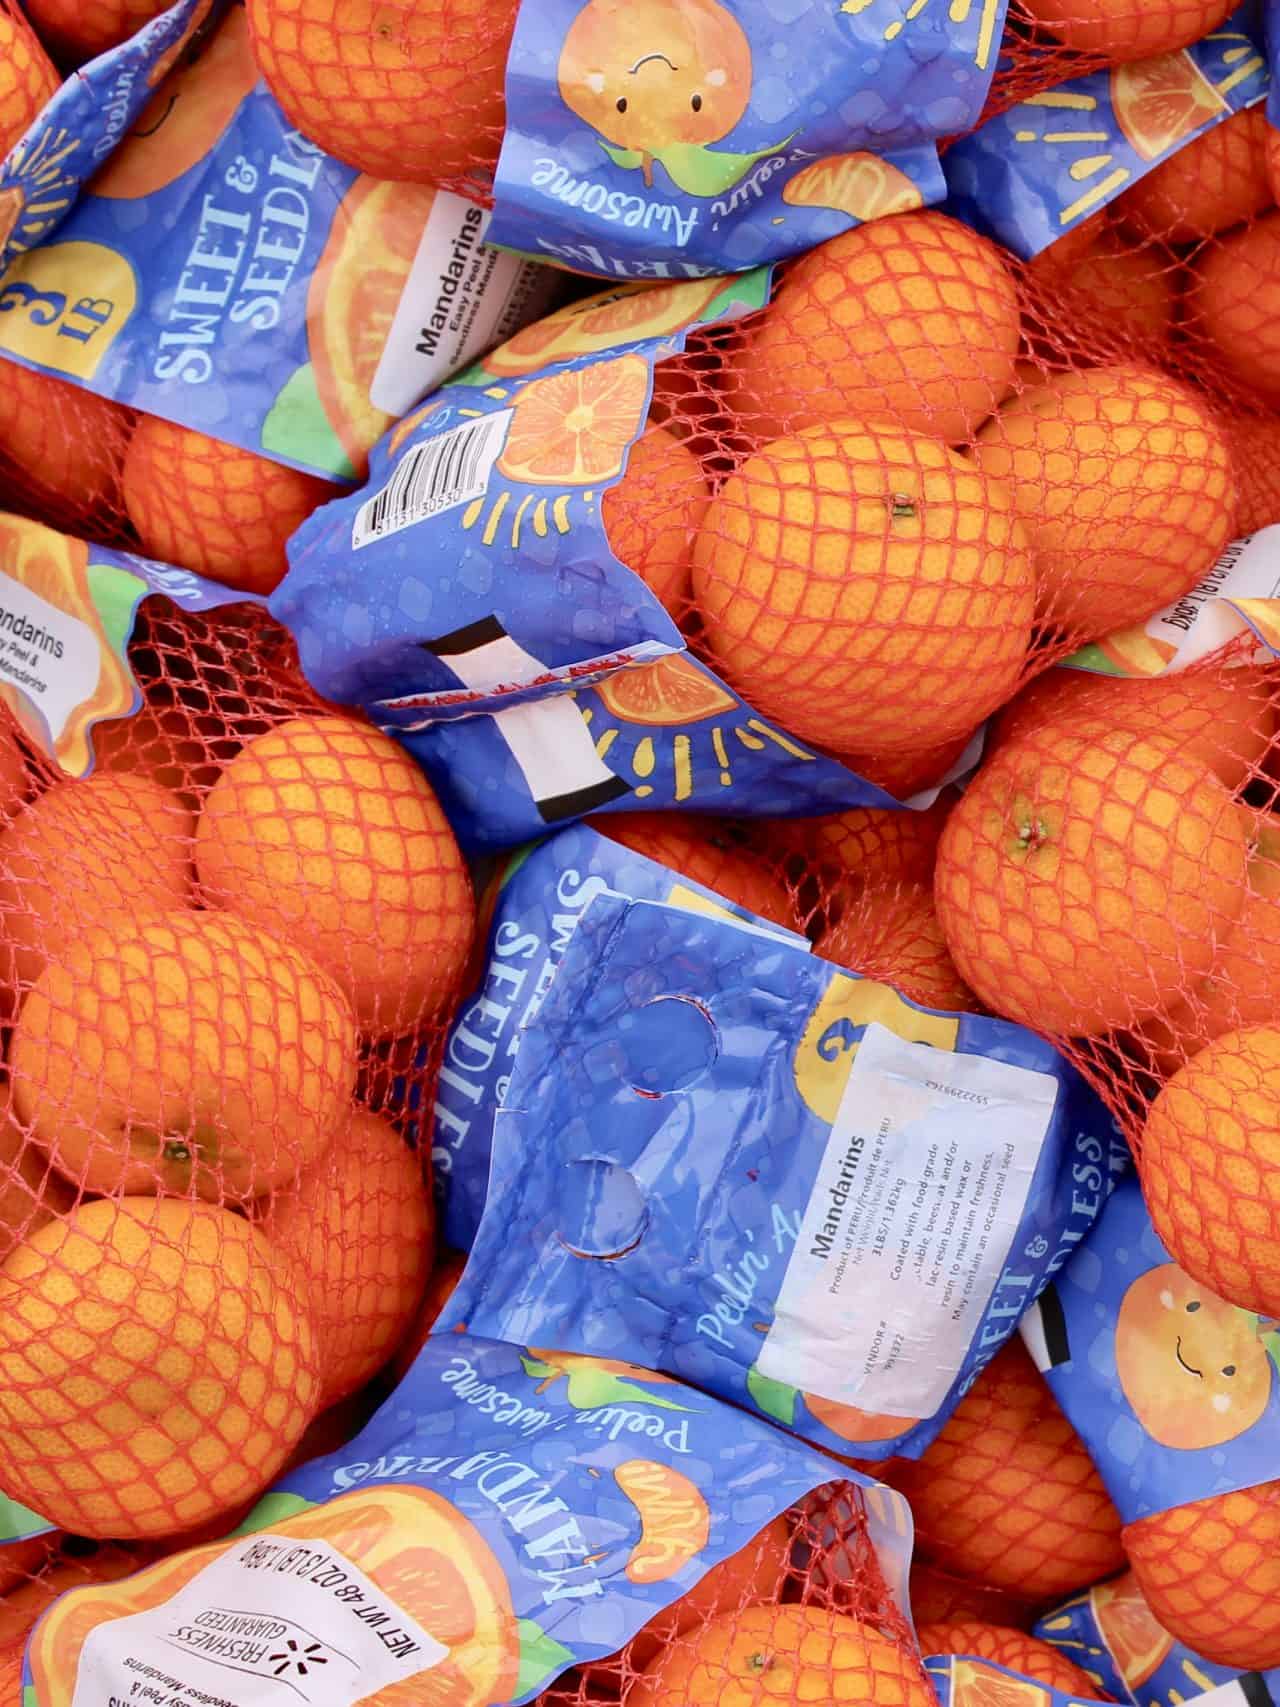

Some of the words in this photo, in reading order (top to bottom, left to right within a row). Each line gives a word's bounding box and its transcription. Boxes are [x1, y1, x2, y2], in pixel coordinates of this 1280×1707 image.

[532, 158, 699, 247] Awesome
[154, 193, 253, 383] SWEET
[225, 155, 258, 194] &
[416, 207, 482, 357] Mandarins
[0, 282, 67, 326] 3
[449, 296, 471, 332] Easy
[464, 260, 483, 292] Peel
[56, 297, 115, 344] LB
[0, 608, 64, 659] andarins
[431, 921, 541, 1173] SEEDLES
[873, 1146, 884, 1162] de
[878, 1117, 892, 1147] PERU
[943, 1140, 959, 1179] and/or
[811, 1135, 865, 1260] Mandarins
[944, 1199, 961, 1236] based
[956, 1174, 969, 1200] wax
[963, 1159, 973, 1174] or
[846, 1233, 856, 1250] of
[890, 1240, 910, 1281] Coated
[907, 1212, 919, 1239] with
[951, 1295, 969, 1322] May
[963, 1255, 983, 1296] contain
[977, 1234, 989, 1251] an
[983, 1171, 1006, 1233] occasional
[1000, 1141, 1015, 1171] seed
[1024, 1234, 1049, 1260] &
[831, 1249, 850, 1294] Product
[941, 1277, 957, 1309] resin
[951, 1262, 962, 1277] to
[957, 1207, 976, 1262] maintain
[696, 1229, 769, 1349] Peelin'
[863, 1330, 885, 1376] VENDOR
[440, 1358, 560, 1438] Awesome
[555, 1407, 694, 1453] Peelin'
[331, 1450, 605, 1604] MANDARINS
[310, 1563, 348, 1589] OZ
[333, 1584, 366, 1604] 48
[194, 1610, 287, 1638] GUARANTEED
[352, 1606, 392, 1630] WT
[168, 1625, 270, 1665] FRESHNESS
[376, 1627, 421, 1659] NET
[122, 1657, 187, 1692] Mandarins
[138, 1686, 169, 1705] Peel
[184, 1687, 240, 1707] eedless
